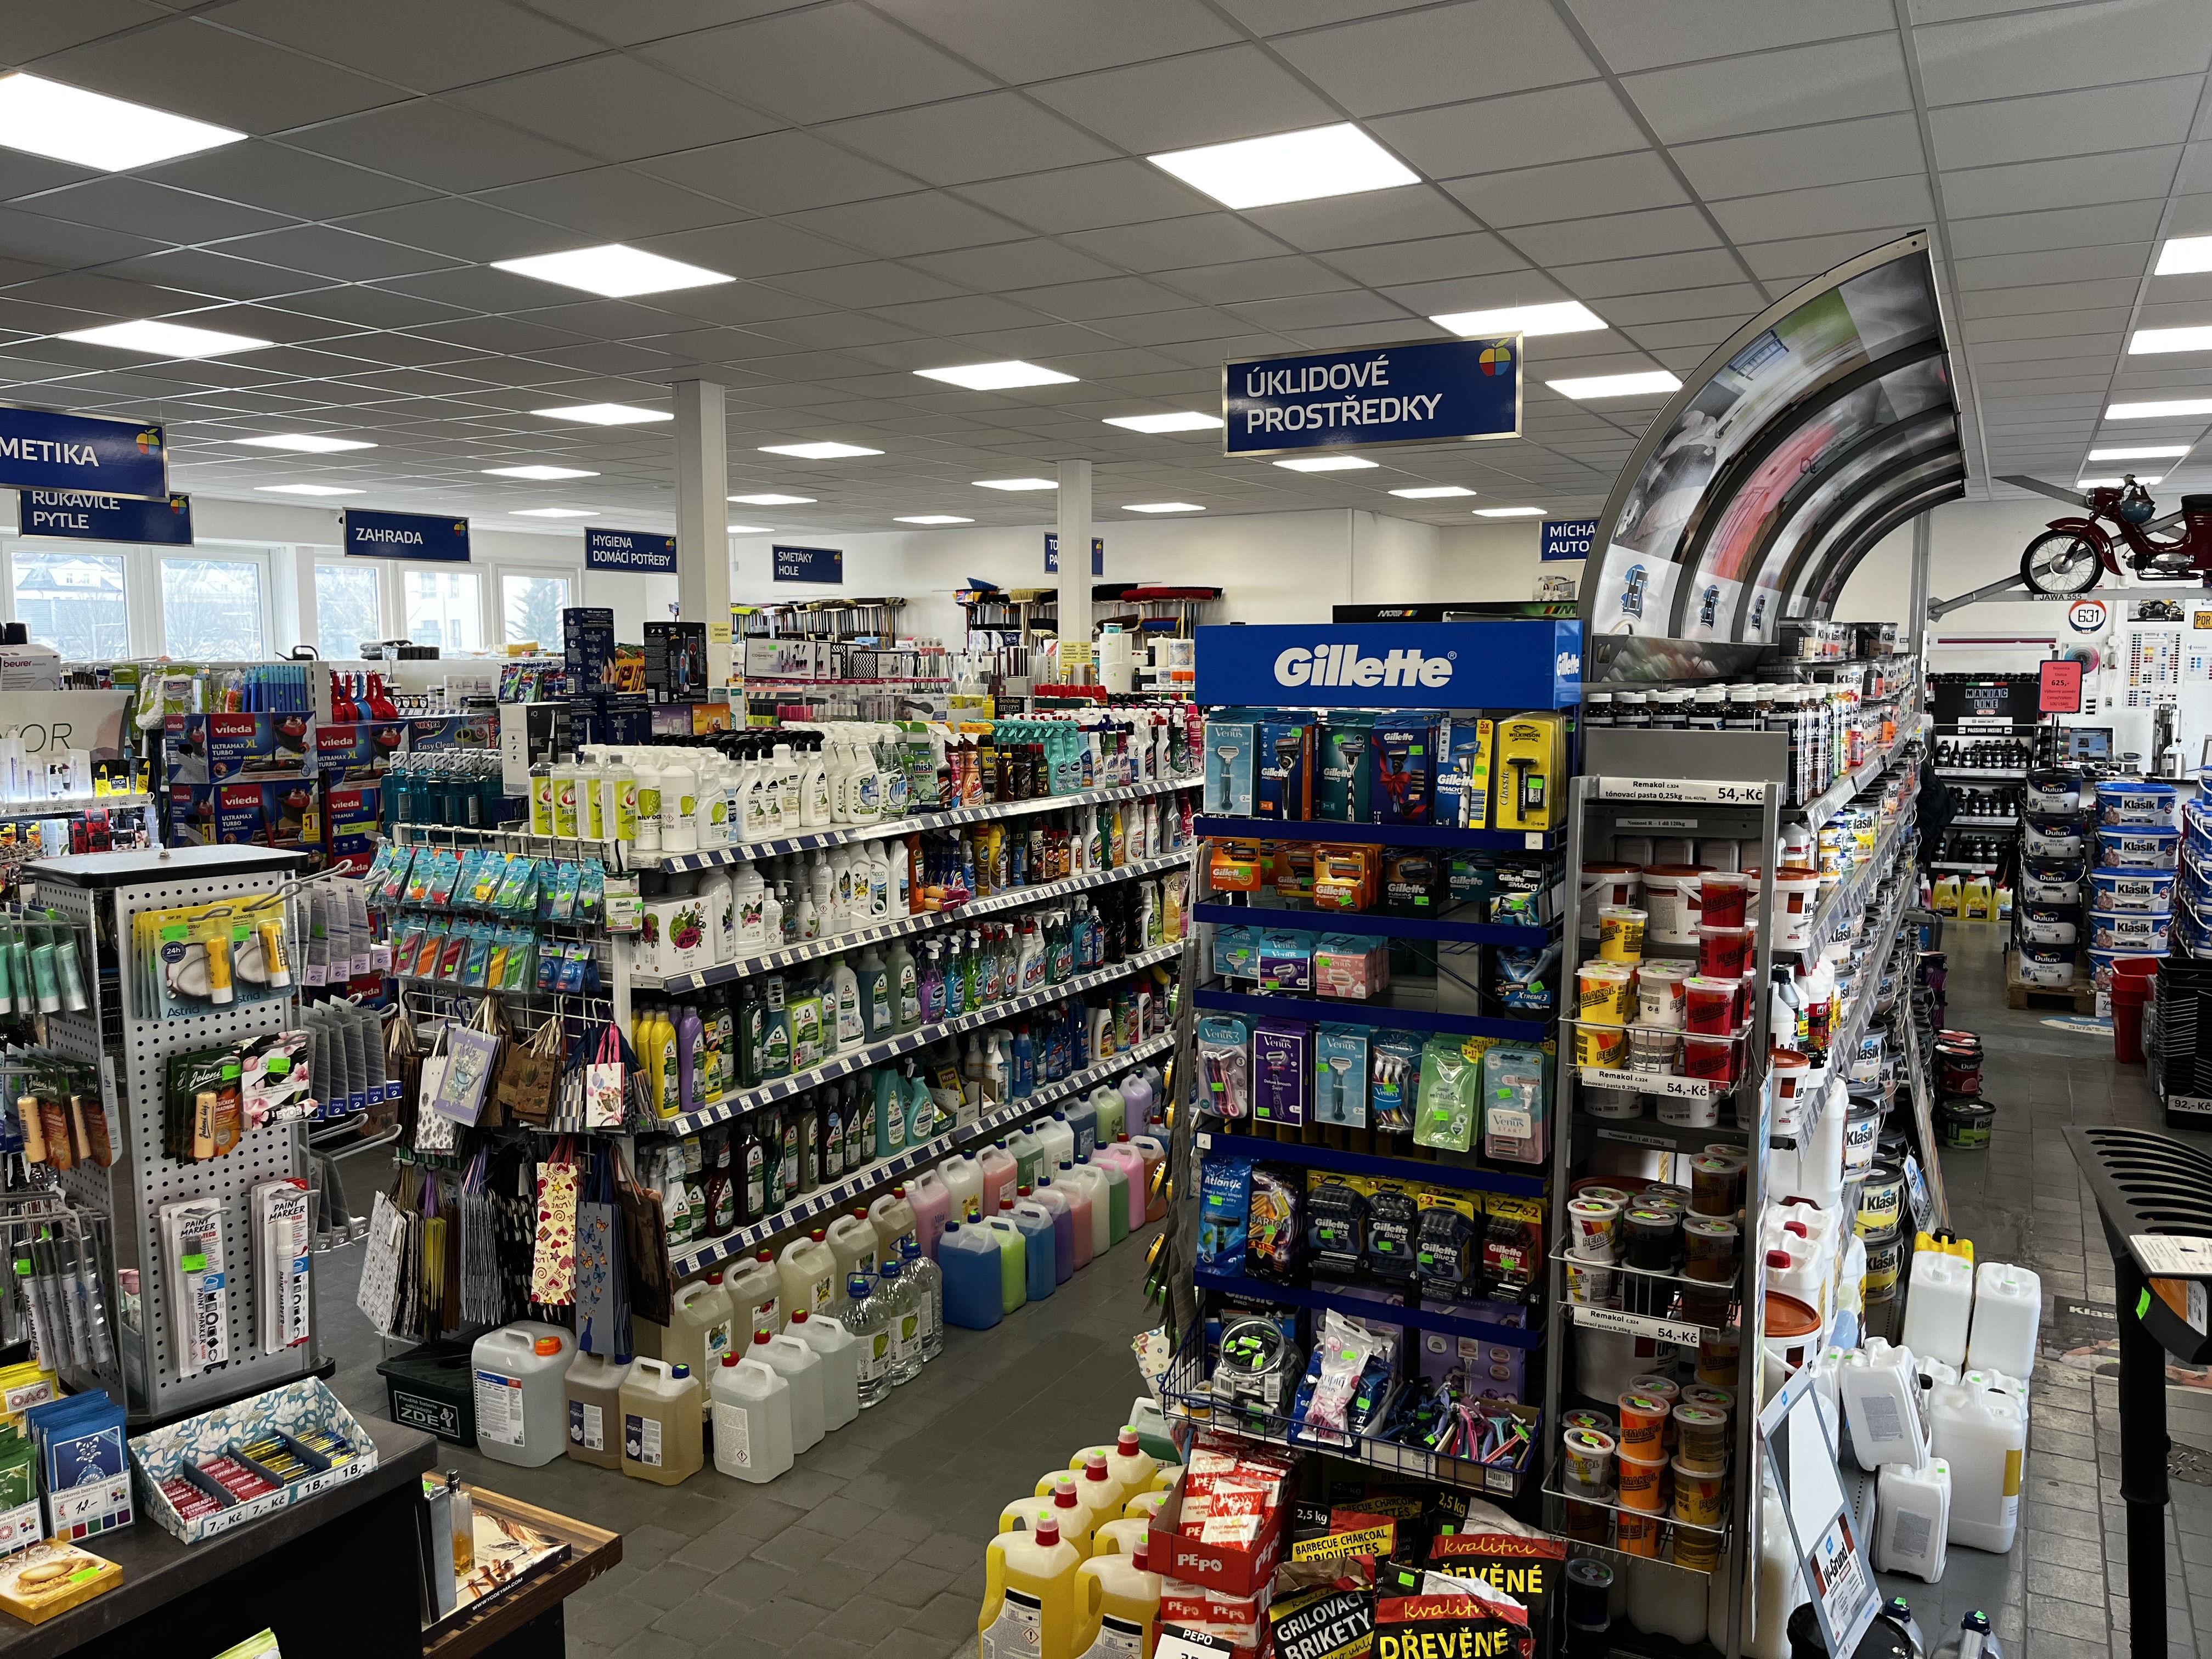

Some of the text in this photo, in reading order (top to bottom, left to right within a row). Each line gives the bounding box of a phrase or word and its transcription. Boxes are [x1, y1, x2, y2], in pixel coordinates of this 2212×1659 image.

[1246, 354, 1389, 397] ÚKLIDOVÉ
[1246, 393, 1442, 434] PROSTŘEDKY
[33, 511, 89, 529] PYTLE
[356, 527, 424, 545] ZAHRADA
[1549, 523, 1595, 538] MÍCHÁ
[592, 534, 633, 549] HYGIENA
[1548, 540, 1589, 554] AUTO
[593, 550, 670, 567] DOMÁCÍ POTŘEBY
[778, 550, 812, 563] SMETÁKY
[778, 565, 799, 576] HOLE
[2078, 610, 2099, 622] 631
[1274, 644, 1453, 688] Gillette
[1556, 651, 1580, 676] Gillette
[1966, 689, 2007, 697] MANIAC
[1975, 699, 1997, 708] LINE
[215, 724, 252, 734] vileda
[1215, 727, 1243, 738] Venus
[320, 737, 353, 747] vileda
[1384, 732, 1414, 741] Gillette
[245, 739, 258, 749] XL
[417, 741, 455, 752] Easy Clean
[347, 751, 358, 759] XL
[1261, 767, 1288, 777] Gillette
[1324, 767, 1351, 777] Gillette
[1437, 774, 1476, 787] Gillette
[1499, 769, 1508, 805] Classic
[225, 797, 258, 806] vileda
[1658, 792, 1683, 800] 0,25kg
[1717, 787, 1763, 802] 54,-Kč
[332, 799, 359, 809] vileda
[2124, 799, 2155, 810] Klasik
[2124, 842, 2155, 852] Klasik
[1449, 876, 1483, 885] Gillette
[1498, 874, 1525, 883] Gillette
[1316, 885, 1352, 896] Gillette
[1387, 883, 1426, 894] Gillette
[2118, 884, 2150, 894] Klasik
[679, 934, 698, 947] green
[1272, 940, 1297, 950] Venus
[238, 992, 260, 1003] strid
[167, 1005, 200, 1018] Astrid
[1204, 1027, 1233, 1039] Venus
[1263, 1036, 1291, 1049] Venus
[1326, 1037, 1356, 1051] Venus
[1599, 1070, 1633, 1081] Remakol
[1583, 1080, 1606, 1088] tónovací
[1606, 1082, 1622, 1091] pasta
[1667, 1082, 1707, 1097] 54,-Kč
[2174, 1099, 2211, 1111] 92,- Kč
[278, 1107, 301, 1119] RYOR
[1493, 1114, 1524, 1127] Venus
[1846, 1125, 1874, 1146] Klasik
[1205, 1176, 1242, 1189] Atlantic
[274, 1200, 299, 1212] PAINT
[1867, 1192, 1898, 1210] Klasik
[269, 1205, 306, 1222] MARKER
[180, 1222, 216, 1237] MARKER
[185, 1218, 208, 1228] PAINT
[1250, 1213, 1290, 1233] BARTON
[1315, 1217, 1350, 1231] Gillette
[1373, 1222, 1409, 1234] Gillette
[1421, 1242, 1458, 1257] Gillette
[1488, 1243, 1522, 1257] Gillette
[1590, 1311, 1624, 1322] Remakol
[198, 1312, 206, 1345] MARKER
[1657, 1328, 1698, 1344] 54,-Kč
[400, 1407, 439, 1426] ZDE
[1621, 1424, 1662, 1438] REMAKOL
[342, 1464, 366, 1478] 18,-
[53, 1489, 80, 1502] Prášková
[81, 1484, 98, 1494] barva
[107, 1476, 127, 1486] vajíčka
[304, 1479, 331, 1493] 18,-
[182, 1497, 212, 1512] EVEREADY
[253, 1494, 285, 1515] 7,- Kč
[1439, 1492, 1466, 1516] 2,5 kg
[209, 1511, 242, 1532] 7,- Kč
[1297, 1509, 1328, 1526] 2,5 kg
[1296, 1529, 1387, 1555] BARBECUE CHARCOAL
[1255, 1531, 1280, 1575] PEPO
[1177, 1553, 1222, 1572] PEPO
[1167, 1601, 1199, 1616] PEPO
[1212, 1605, 1245, 1621] PEPO
[1277, 1592, 1365, 1641] GRILOVACÍ
[1182, 1628, 1213, 1646] PEPO
[1284, 1607, 1372, 1659] BRIKETY
[1379, 1627, 1509, 1659] DŘEVĚNÉ
